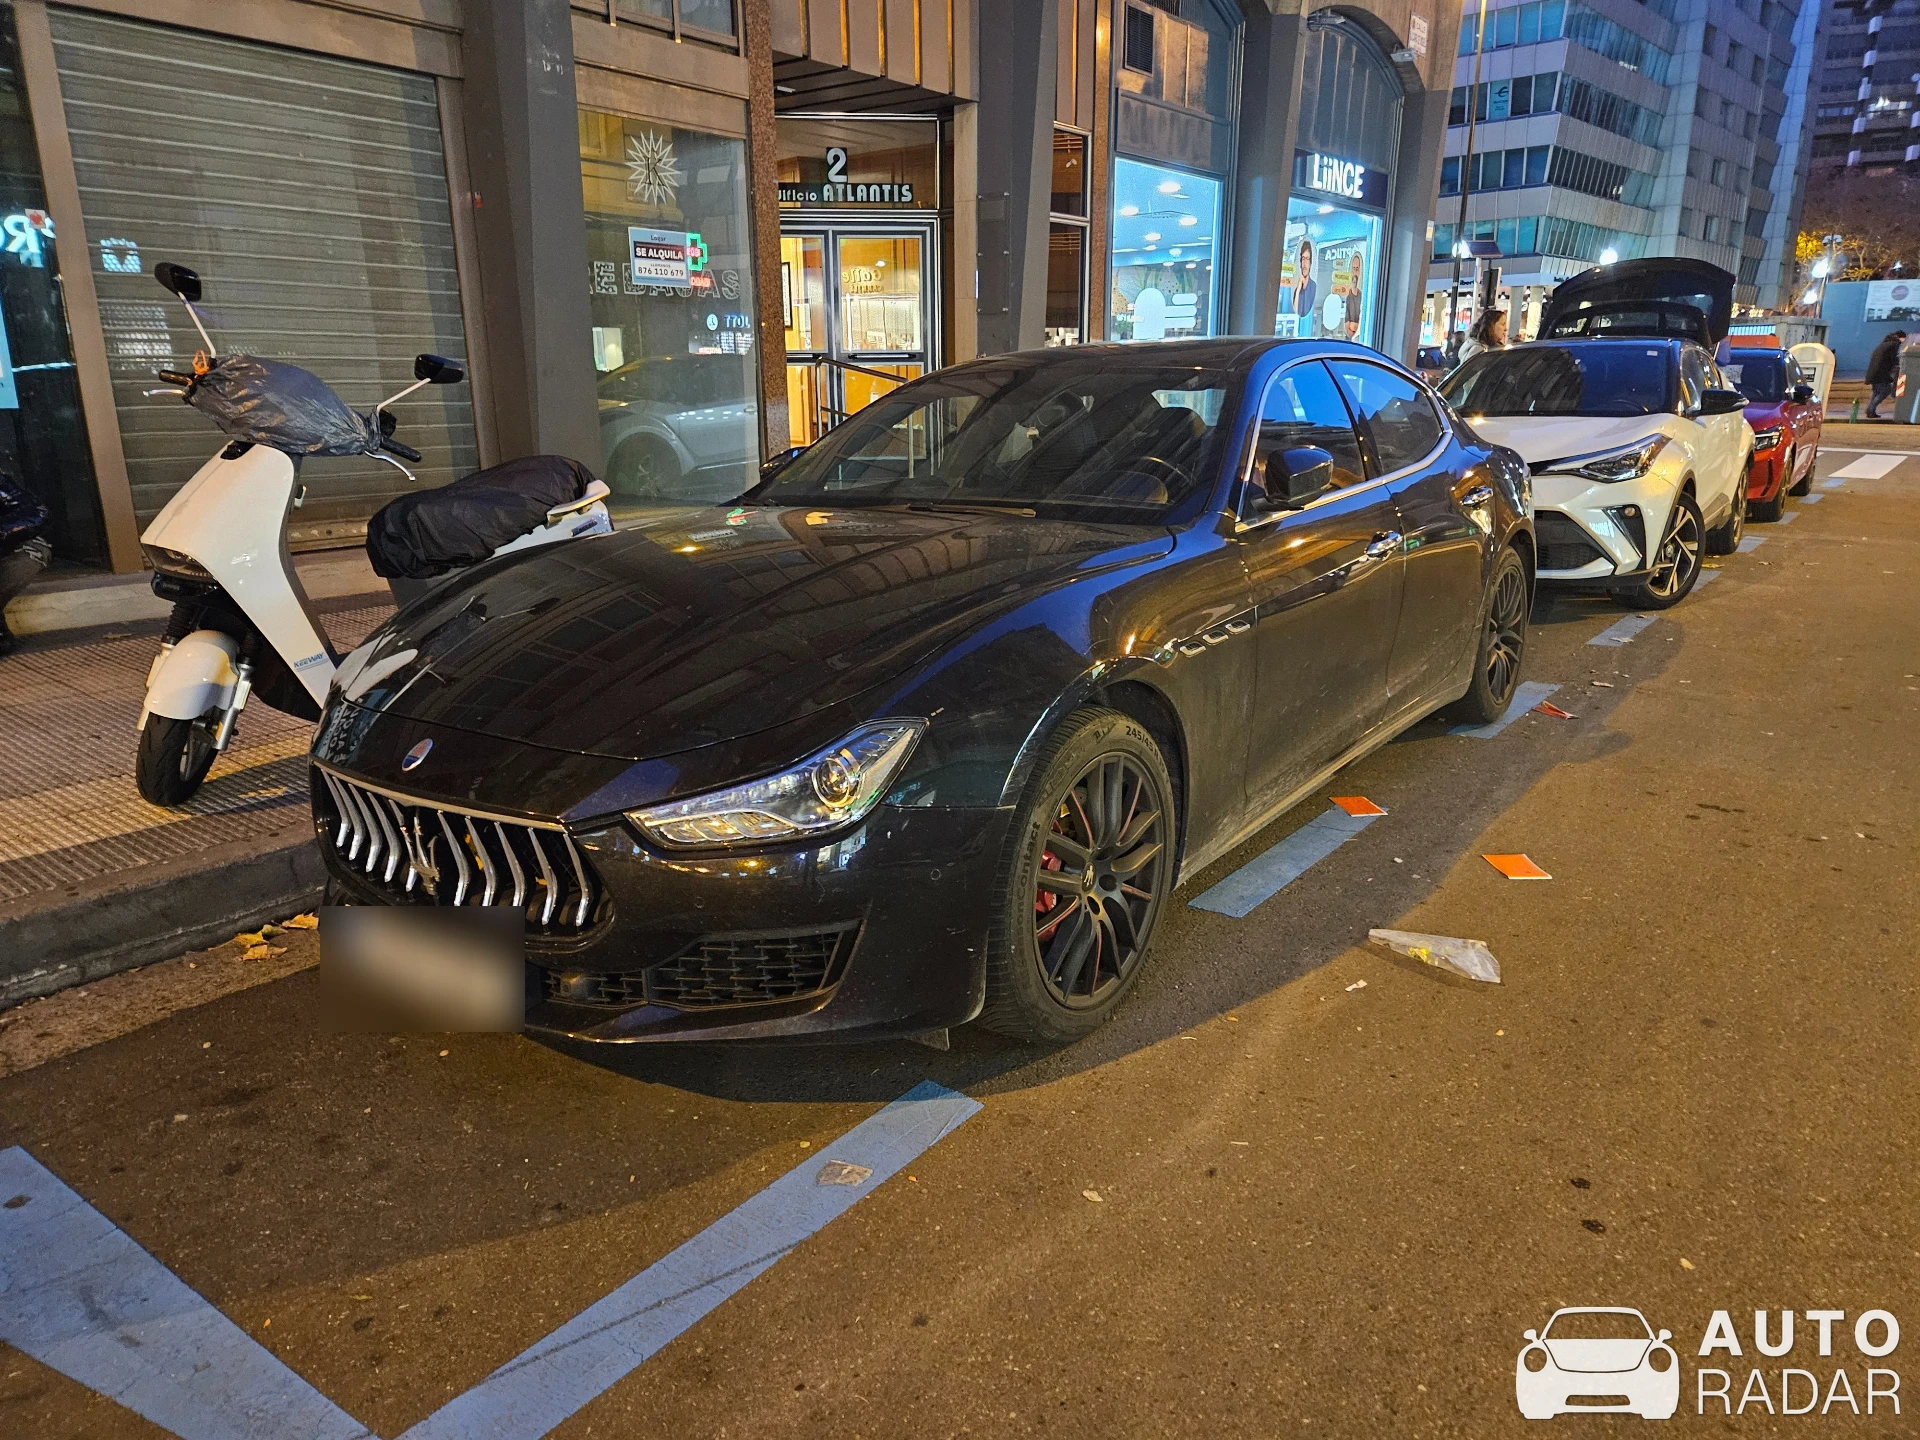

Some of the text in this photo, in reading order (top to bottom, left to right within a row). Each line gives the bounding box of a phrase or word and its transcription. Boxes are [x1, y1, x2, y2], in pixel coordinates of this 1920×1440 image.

[827, 147, 848, 183] 2
[778, 183, 913, 202] ificio ATLANTIS
[635, 247, 646, 257] SE
[648, 249, 684, 260] ALQUILA
[638, 266, 684, 277] 876 110 679
